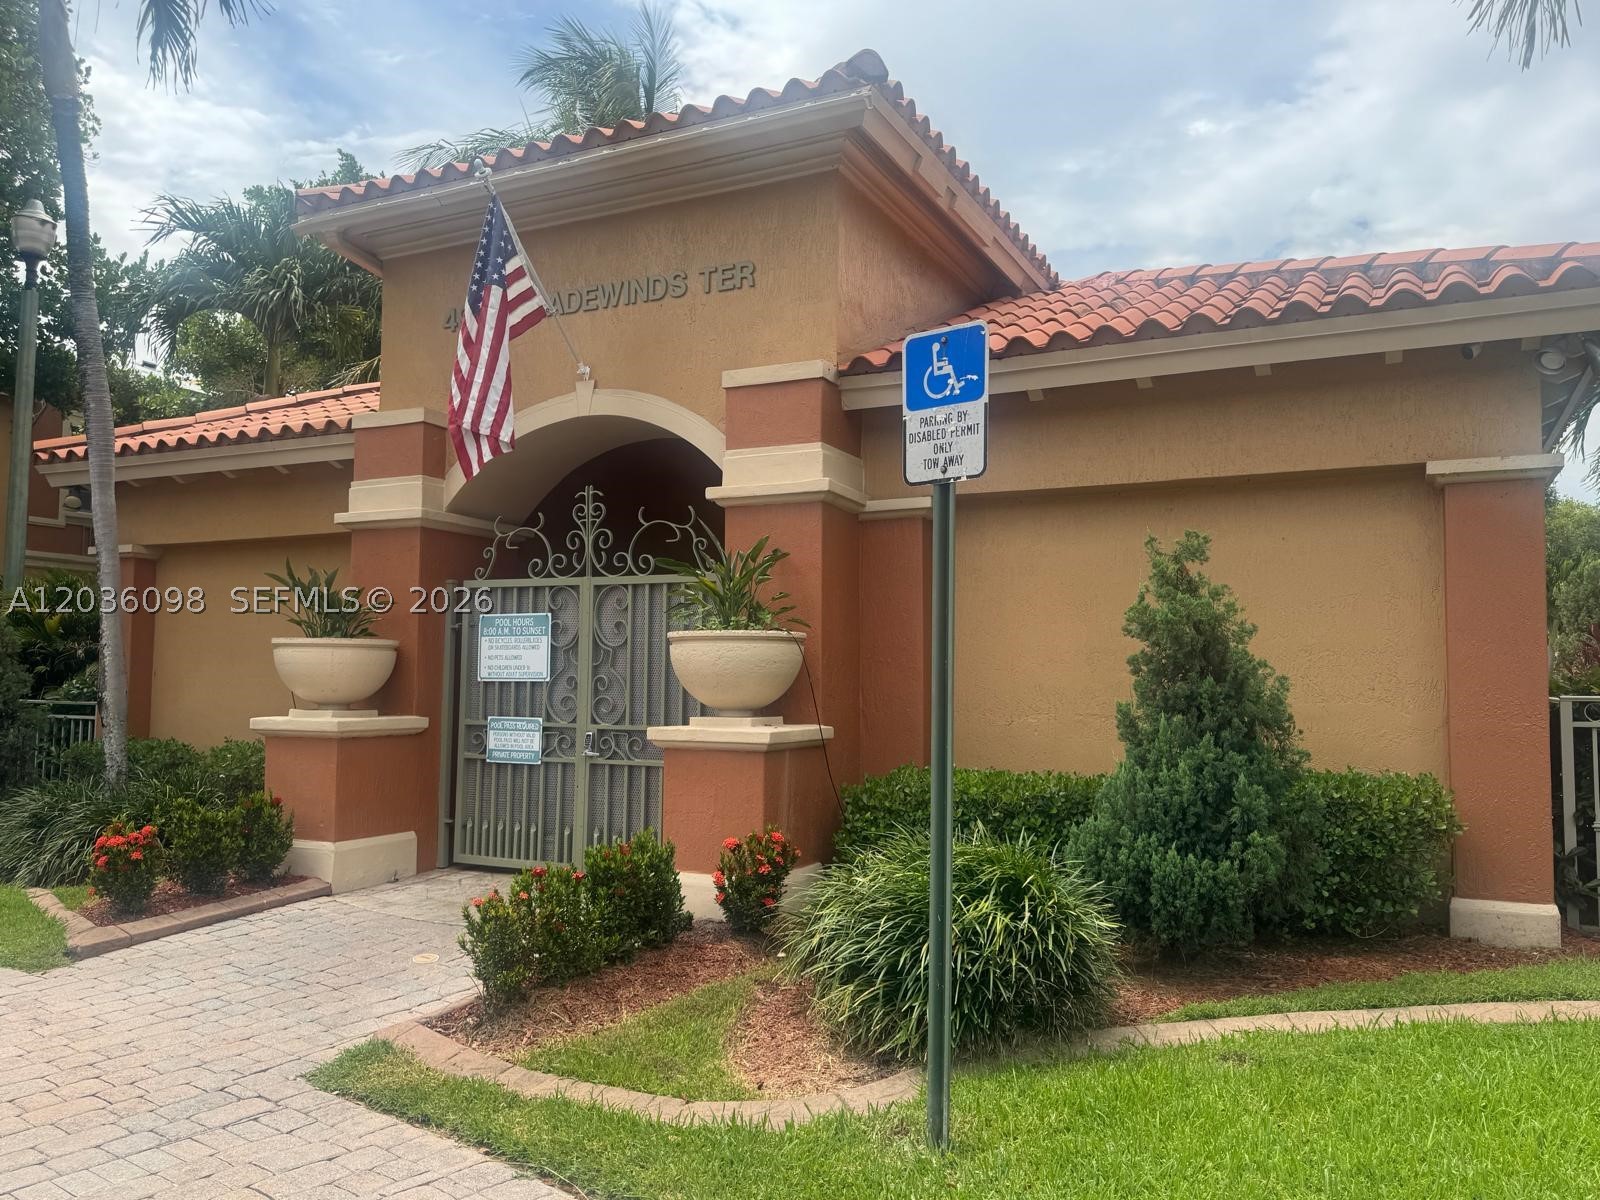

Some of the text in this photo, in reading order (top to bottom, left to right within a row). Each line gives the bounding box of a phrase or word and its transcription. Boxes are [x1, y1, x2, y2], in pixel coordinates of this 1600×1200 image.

[547, 270, 688, 317] ADEWINDS
[699, 261, 756, 295] TER
[958, 410, 968, 423] BY
[908, 428, 946, 444] DISABLED
[934, 442, 953, 454] ONLY
[923, 454, 964, 470] TOW AWAY
[496, 618, 534, 626] POOL HOURS
[483, 626, 546, 636] 8:00 A.M. TO SUNSET
[517, 722, 539, 730] REQUIRED
